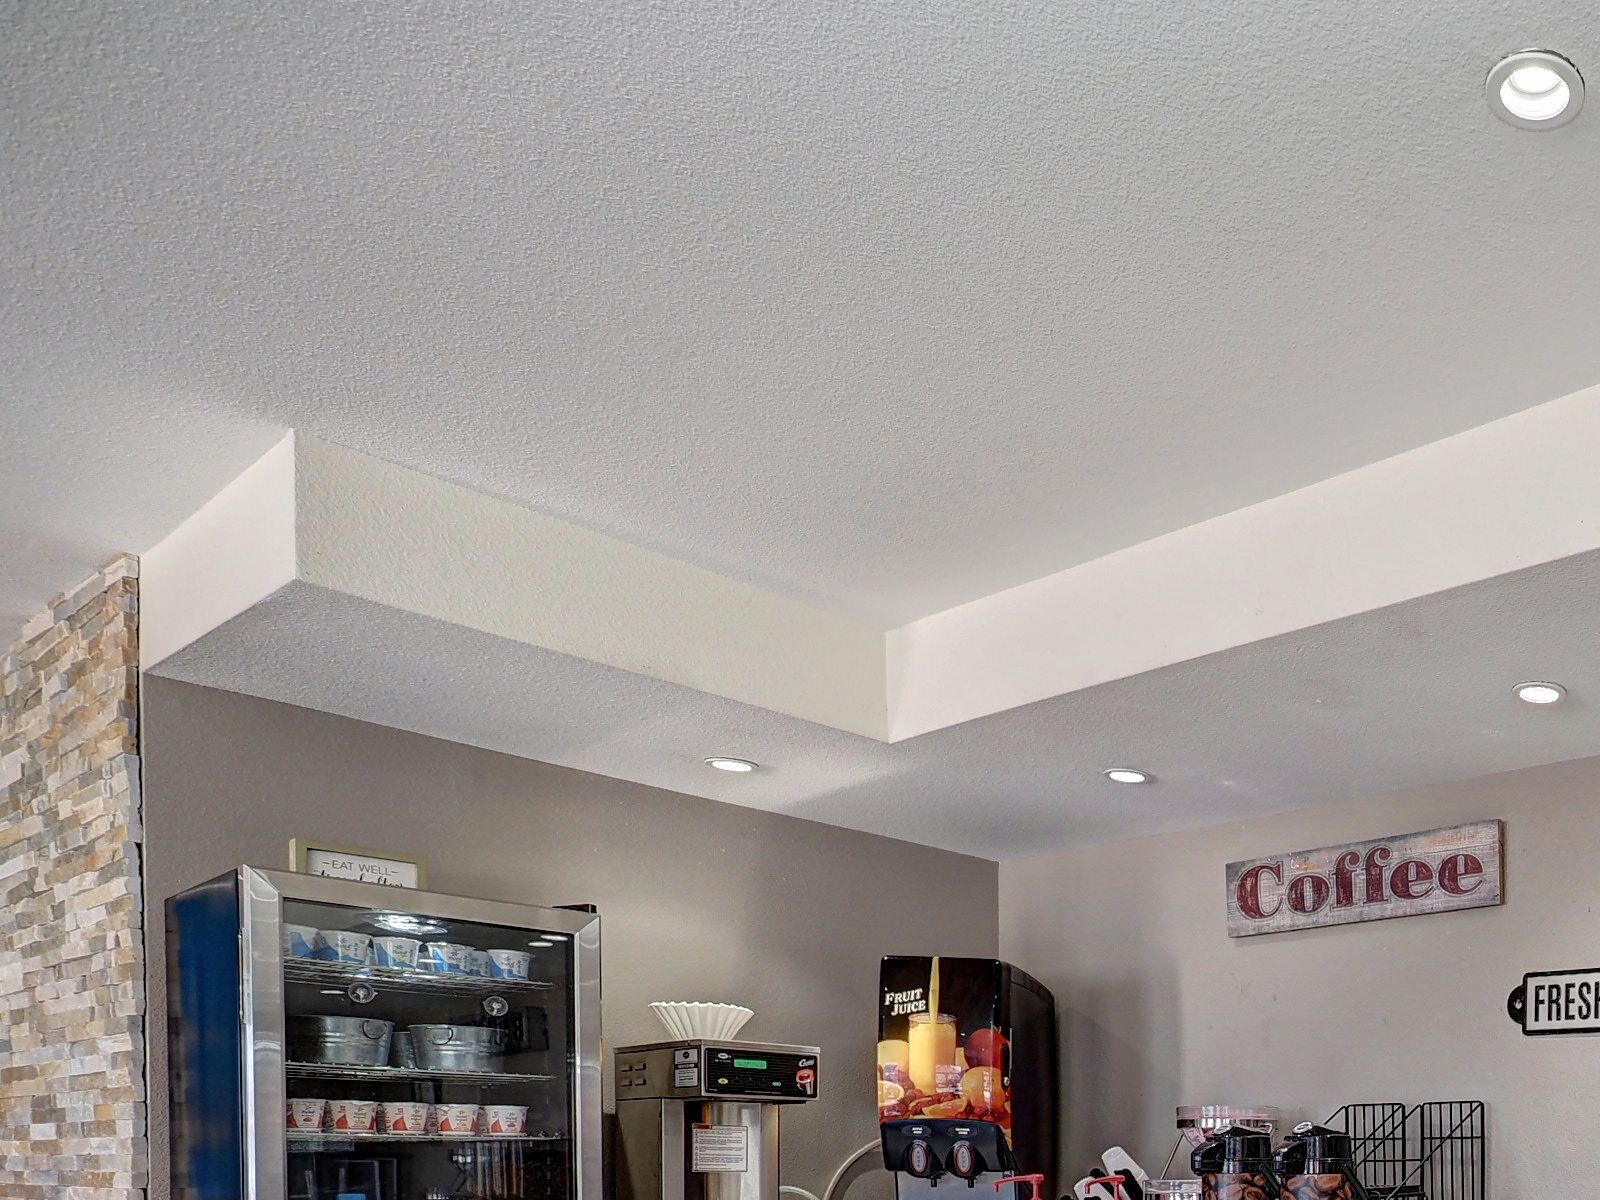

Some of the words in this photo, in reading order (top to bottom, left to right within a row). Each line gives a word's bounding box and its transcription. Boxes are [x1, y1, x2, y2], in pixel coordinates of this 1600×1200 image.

[331, 859, 354, 872] EAT
[358, 863, 391, 877] WELL
[1236, 846, 1486, 920] Coffee
[884, 988, 923, 1006] FRUIT
[891, 1000, 926, 1016] JUICE
